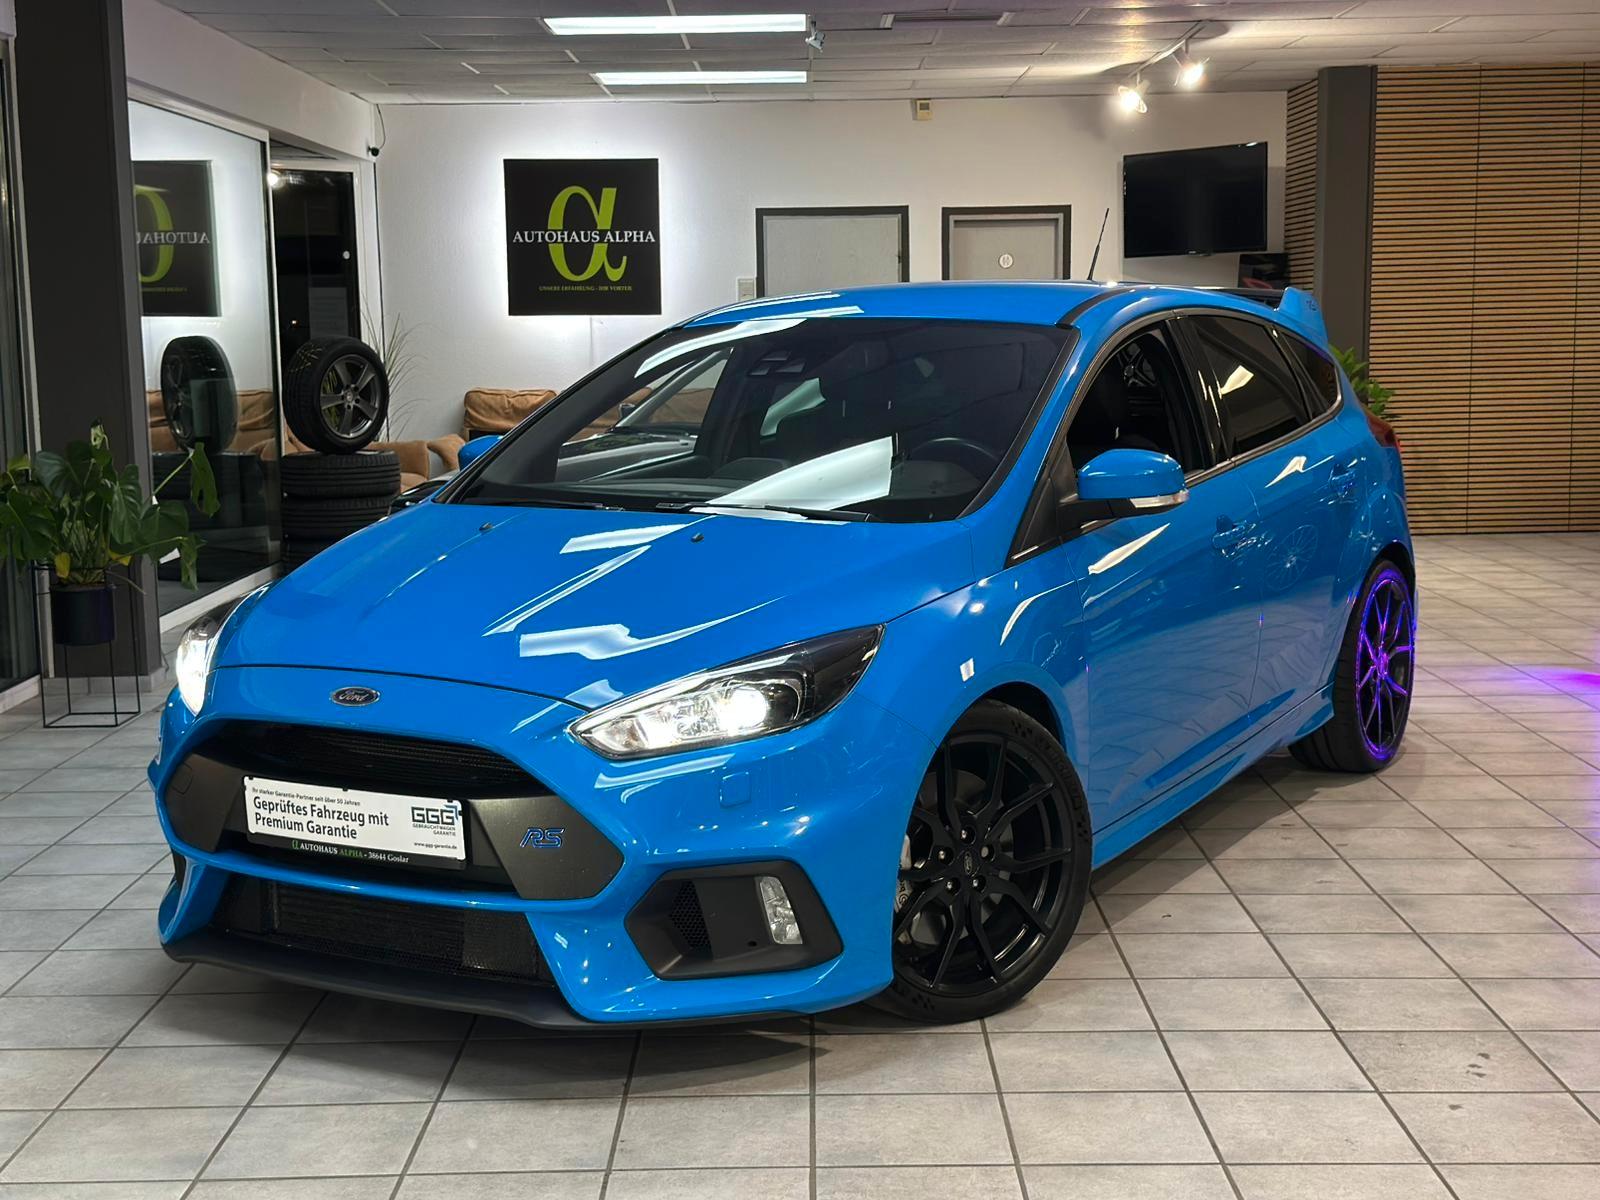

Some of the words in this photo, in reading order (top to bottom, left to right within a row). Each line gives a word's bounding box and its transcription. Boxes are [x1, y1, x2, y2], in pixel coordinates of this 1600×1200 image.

[512, 230, 601, 244] AUTOHAUS
[603, 230, 656, 243] ALPHA
[253, 796, 308, 817] Geprüftes
[310, 804, 365, 827] Fahrzeug
[368, 812, 389, 827] mit
[411, 806, 456, 826] GGG
[255, 812, 304, 832] Premium
[306, 820, 358, 839] Garantie
[433, 829, 456, 837] GARANTIE
[519, 827, 566, 849] RS
[300, 842, 338, 855] AUTOHAUS
[339, 848, 364, 859] ALPHA
[387, 854, 409, 863] Goslar
